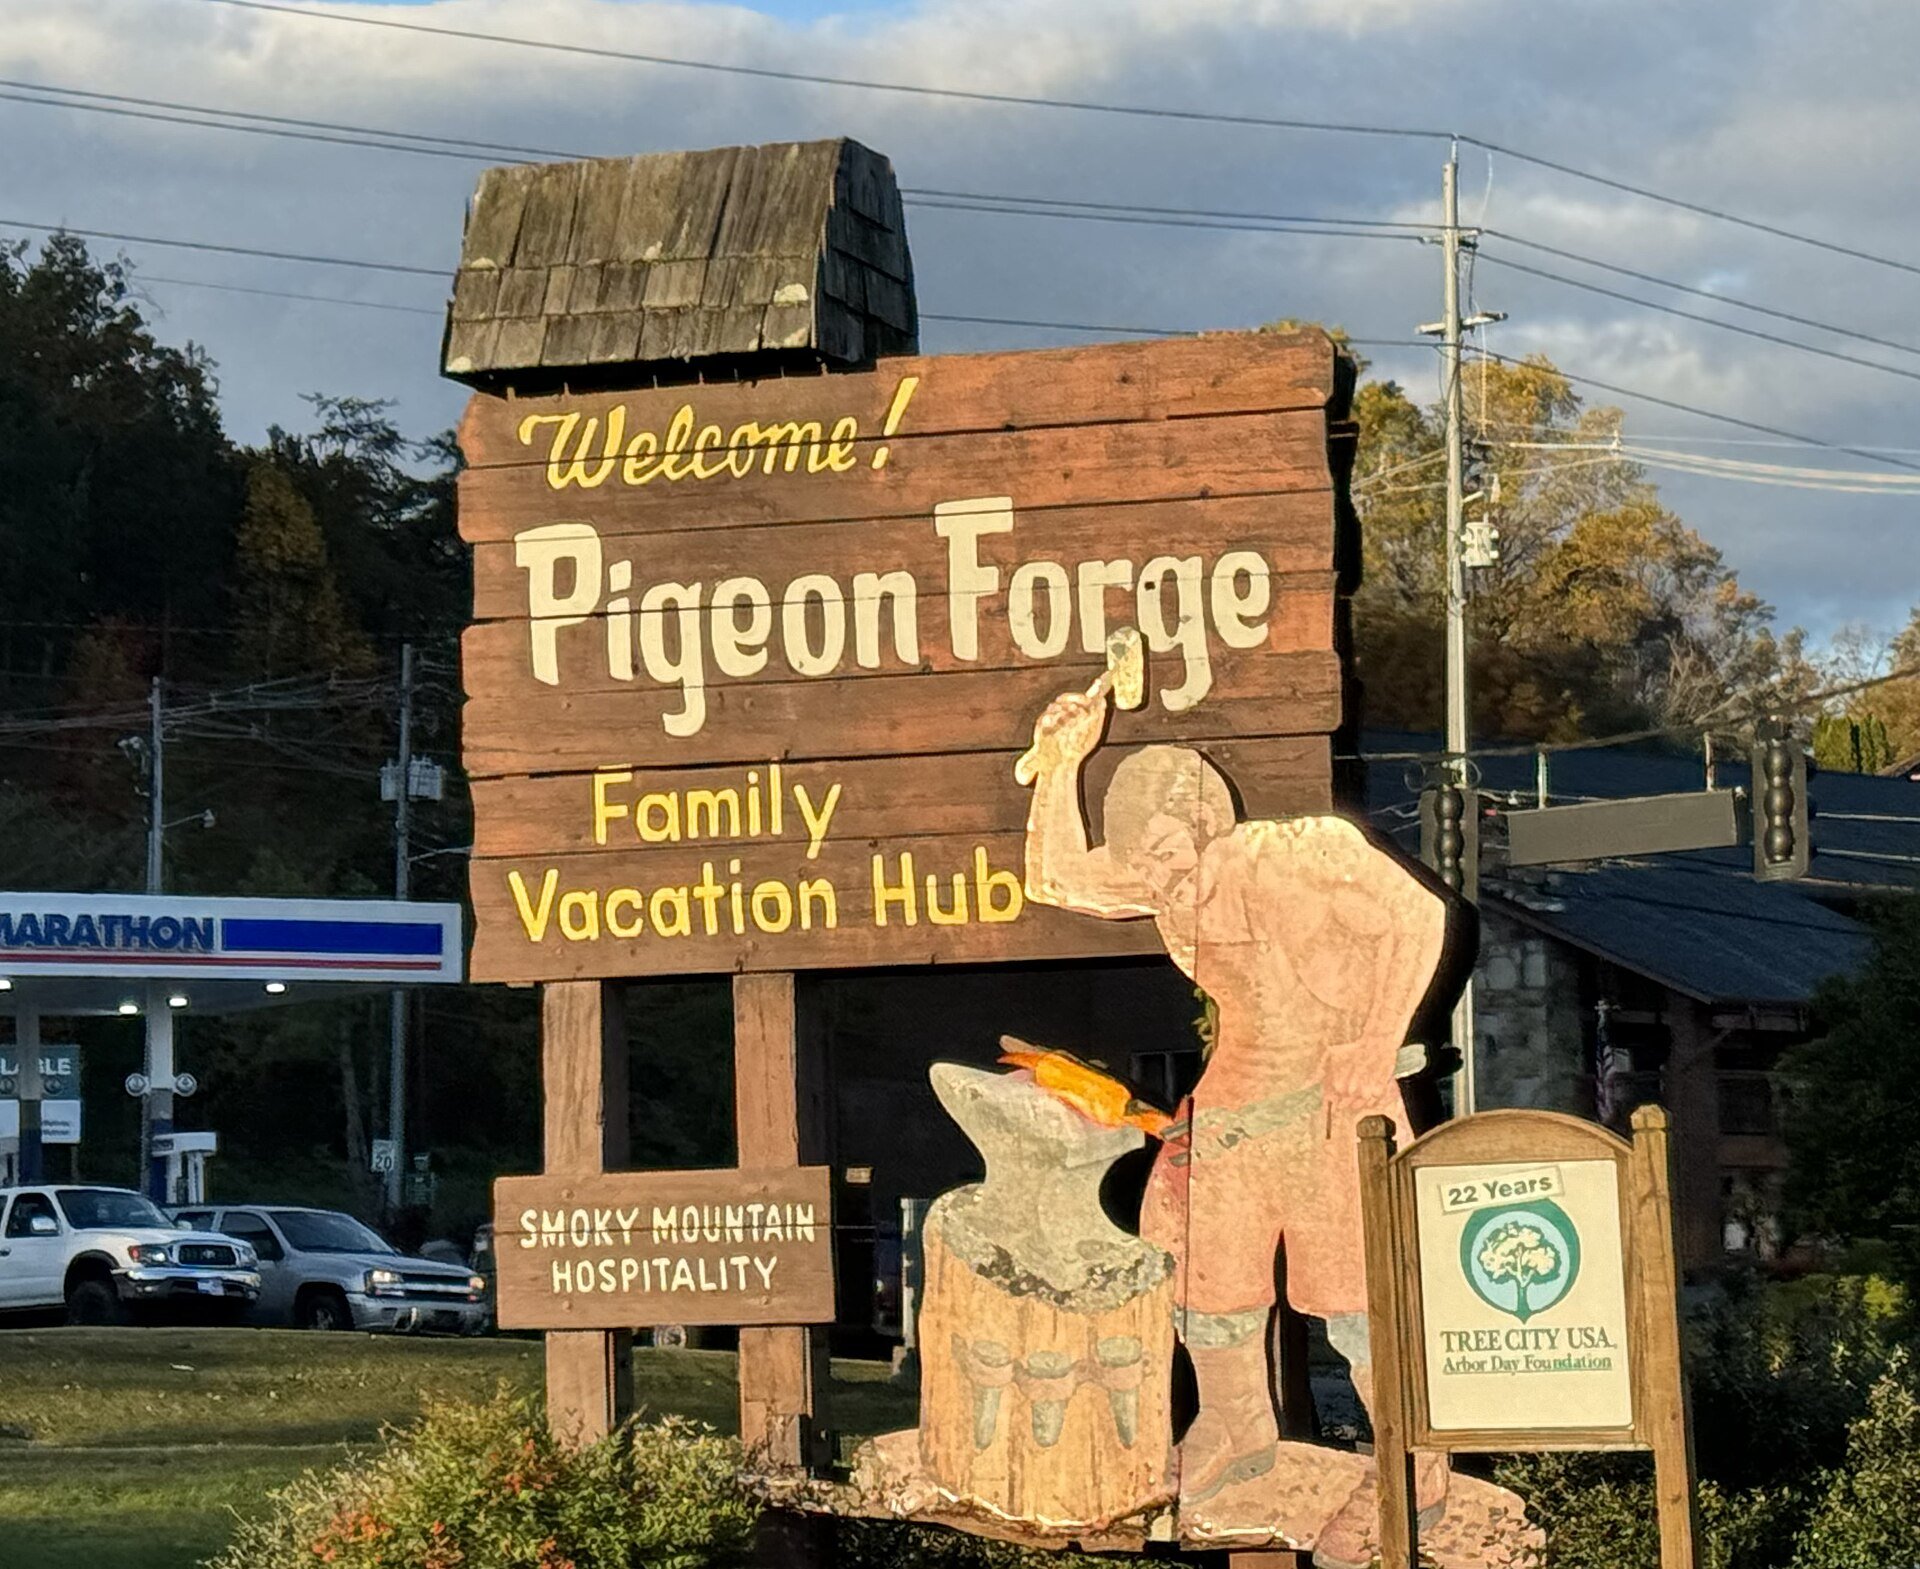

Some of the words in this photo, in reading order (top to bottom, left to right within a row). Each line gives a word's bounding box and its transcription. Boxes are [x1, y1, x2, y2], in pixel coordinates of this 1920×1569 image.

[518, 376, 920, 490] Welcome!
[514, 523, 920, 737] Pigeon
[934, 496, 1271, 711] Forge
[592, 763, 842, 860] Family
[508, 858, 837, 942] Vacation
[872, 846, 1023, 927] Hub
[1448, 1186, 1478, 1205] 22
[1483, 1176, 1553, 1199] Years
[519, 1207, 639, 1249] SMOKY
[652, 1203, 816, 1245] MOUNTAIN
[552, 1255, 778, 1295] HOSPITALITY
[1440, 1329, 1502, 1352] TREE
[1505, 1328, 1560, 1350] CITY
[1443, 1356, 1487, 1373] Arbor
[1491, 1355, 1519, 1376] Day
[1524, 1352, 1612, 1370] Foundation
